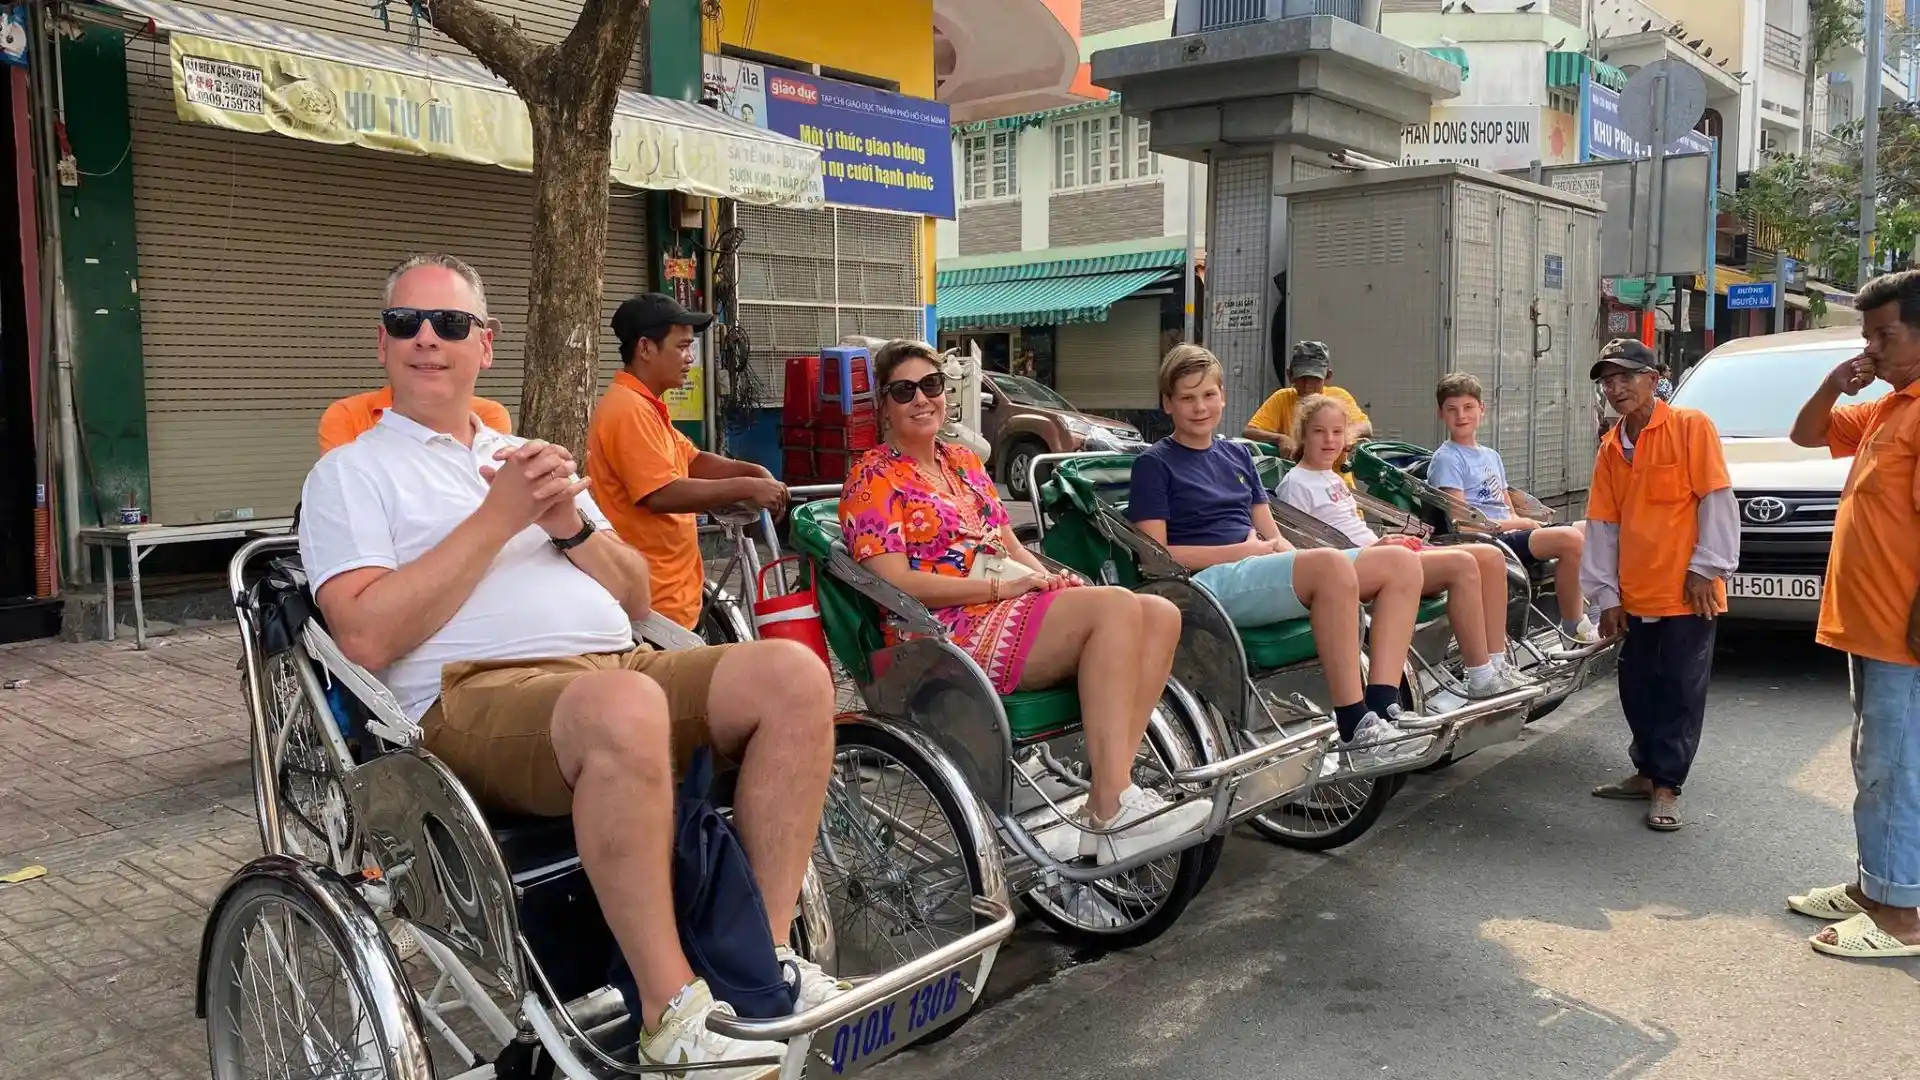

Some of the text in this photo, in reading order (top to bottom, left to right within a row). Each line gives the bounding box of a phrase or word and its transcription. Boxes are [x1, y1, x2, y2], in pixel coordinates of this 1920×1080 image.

[742, 68, 759, 86] ila
[771, 80, 817, 103] giáo dục
[1433, 121, 1467, 145] DONG
[1470, 121, 1503, 145] SHOP
[1506, 121, 1530, 145] SUN
[1593, 118, 1612, 147] KHU
[826, 128, 833, 150] ý
[835, 130, 863, 153] thức
[865, 136, 891, 157] giao
[893, 140, 926, 165] thông
[847, 162, 874, 183] cười
[875, 164, 905, 189] hạnh
[906, 170, 934, 192] phúc
